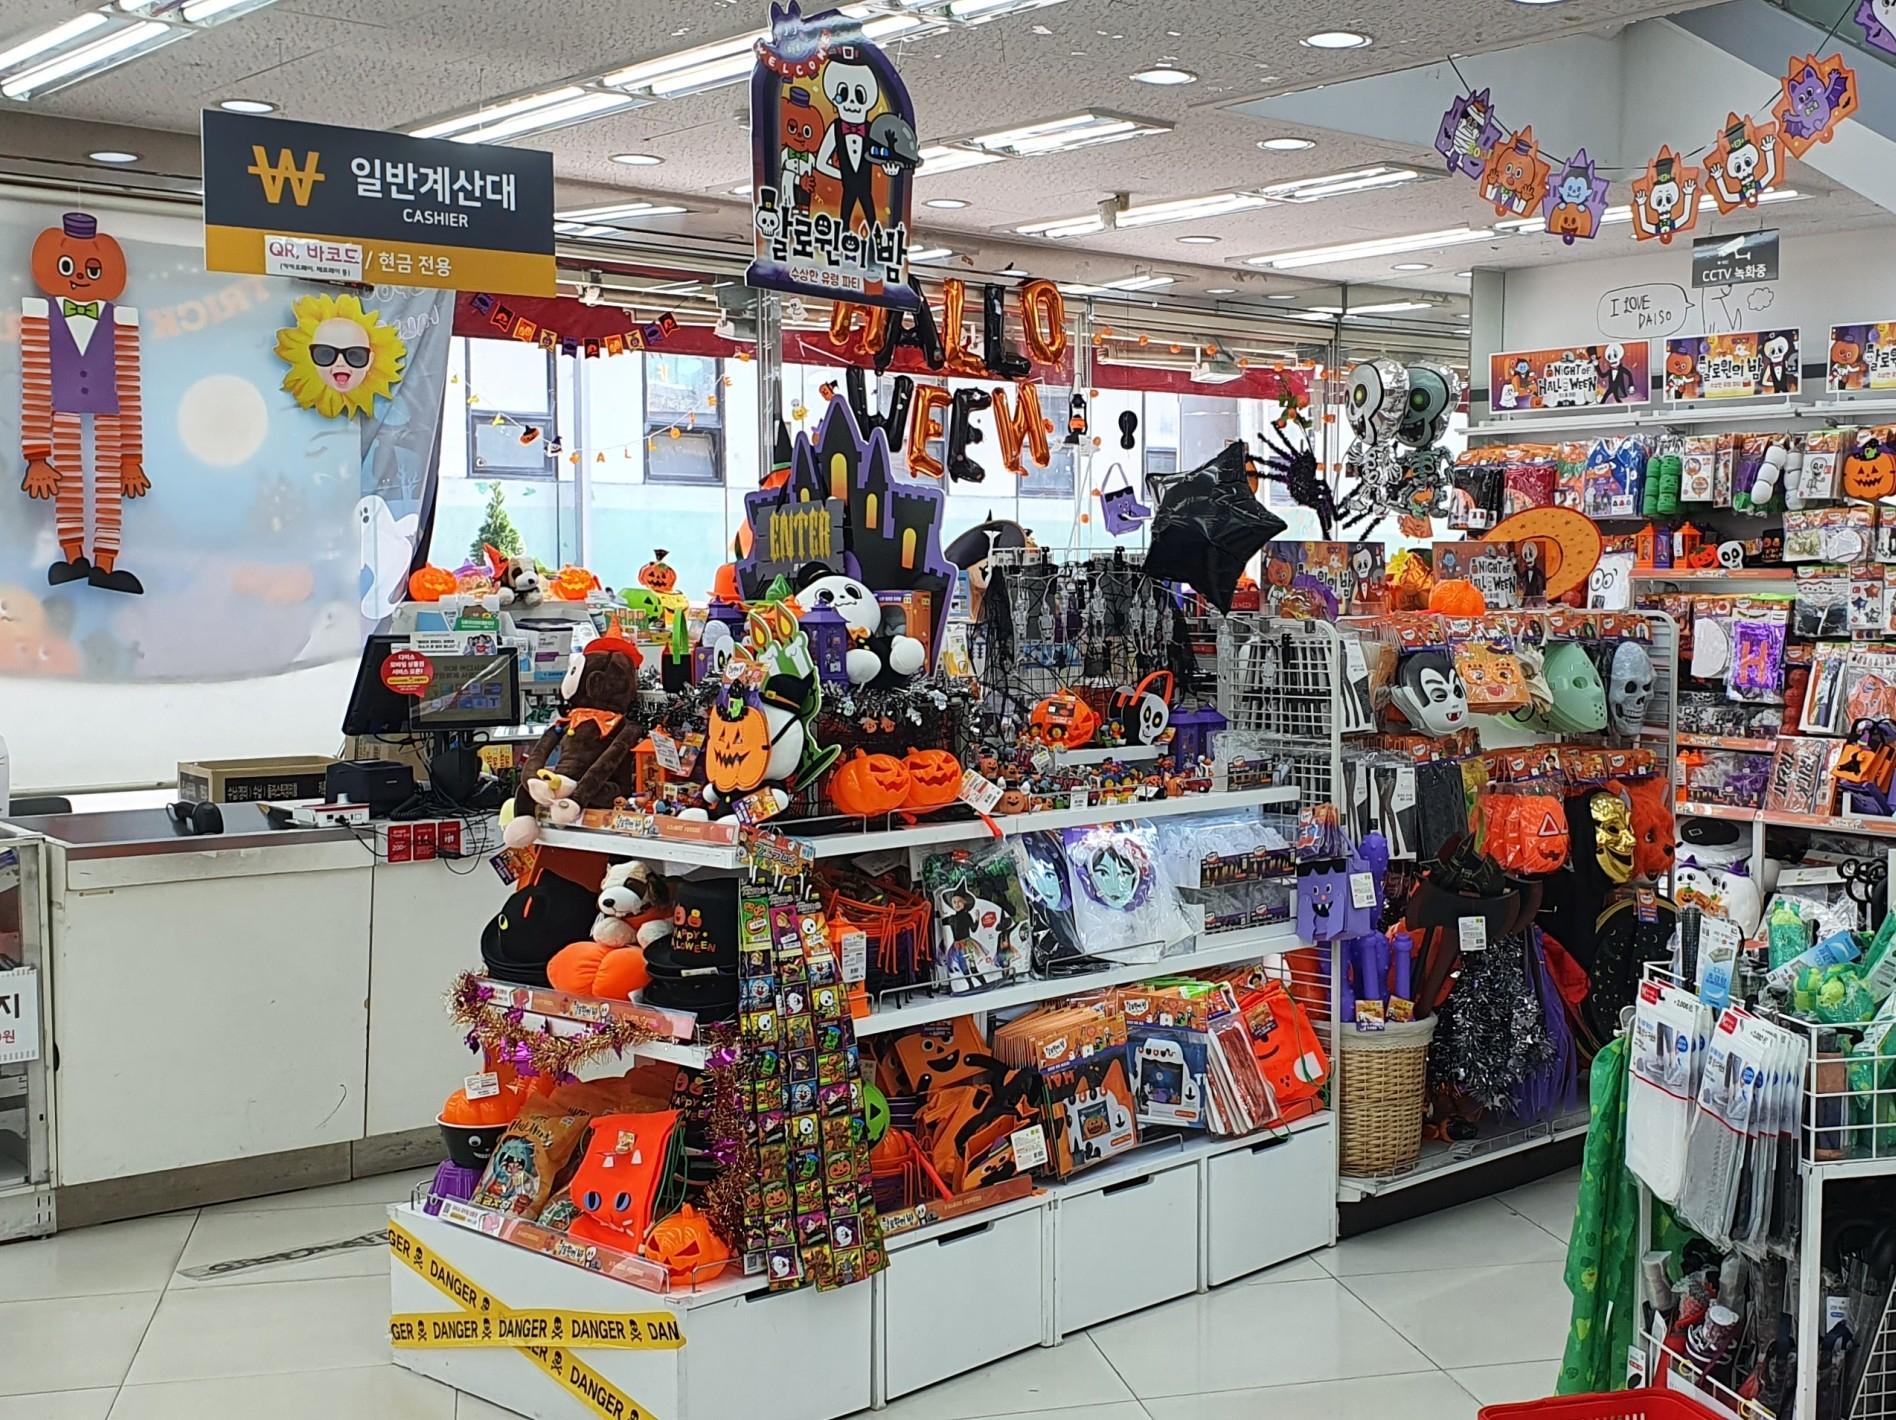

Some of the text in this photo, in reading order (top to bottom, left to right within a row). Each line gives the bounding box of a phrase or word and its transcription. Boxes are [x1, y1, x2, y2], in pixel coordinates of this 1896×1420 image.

[350, 157, 517, 211] 일반계산대
[403, 208, 469, 228] CASHIER
[269, 241, 300, 260] QR,
[306, 244, 361, 265] 바코드
[378, 252, 414, 273] 현금
[418, 256, 452, 277] 전용
[874, 222, 907, 284] 밤
[790, 266, 860, 290] 수상한 유령 파티
[1702, 263, 1767, 282] CCTV 녹화중
[1610, 295, 1652, 318] I LOVE
[1638, 309, 1673, 330] DAISO
[1554, 364, 1592, 377] NIGHT OF
[1747, 353, 1763, 382] 밤
[1538, 377, 1598, 396] HALLOWEEN
[845, 366, 1052, 484] WEEN
[769, 505, 831, 564] ENTER
[1478, 560, 1511, 574] NIGHT OF
[430, 1258, 477, 1309] DANGER
[433, 1319, 479, 1340] DANGER
[498, 1318, 548, 1339] DANGER
[571, 1318, 626, 1341] DANGER
[648, 1320, 681, 1342] DAN
[569, 1364, 625, 1420] DANGER
